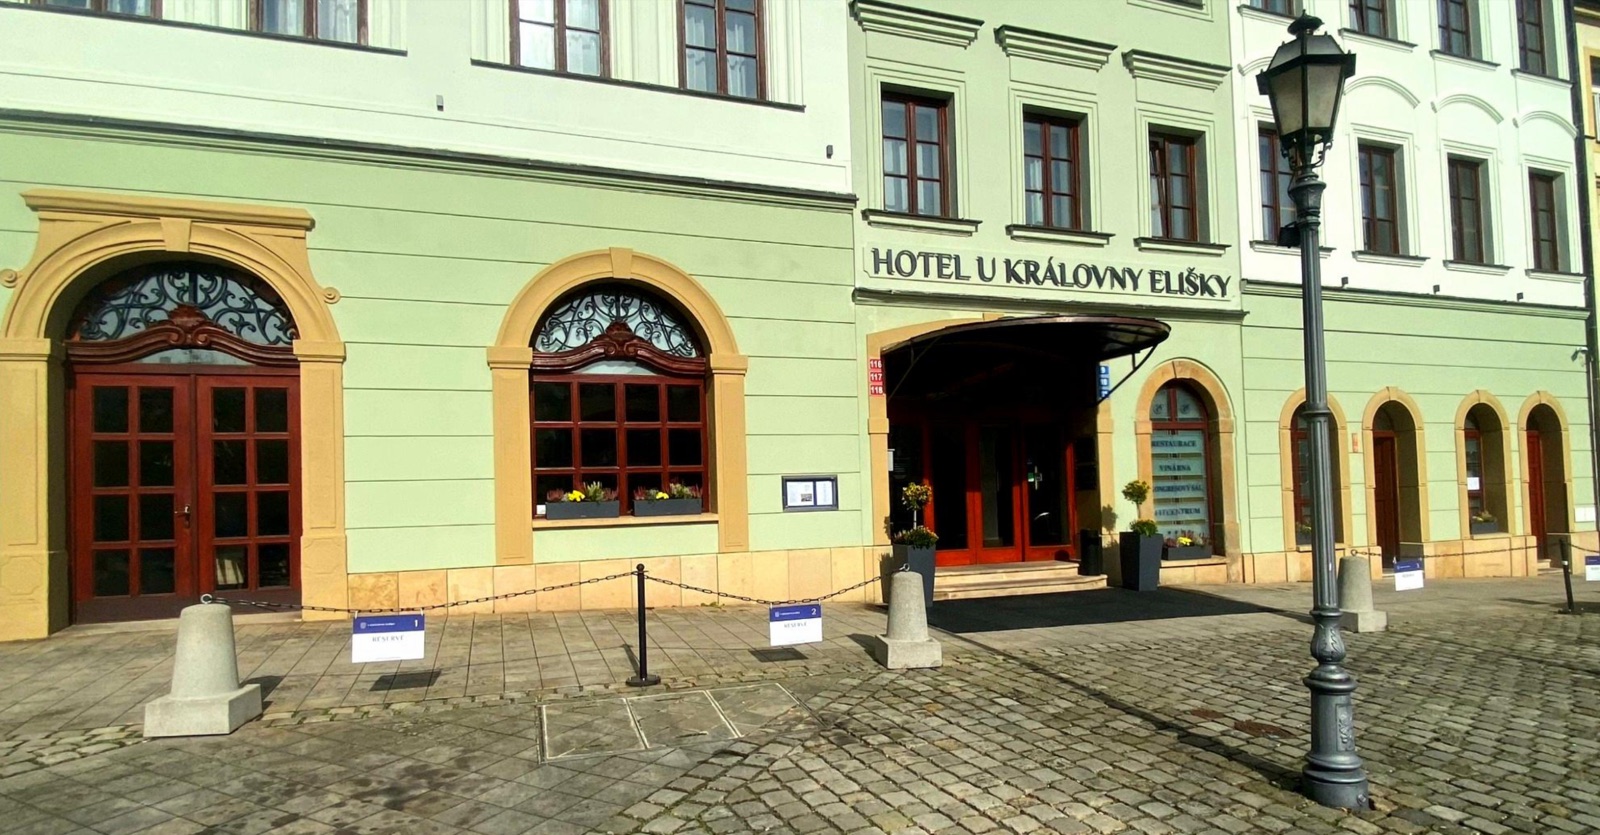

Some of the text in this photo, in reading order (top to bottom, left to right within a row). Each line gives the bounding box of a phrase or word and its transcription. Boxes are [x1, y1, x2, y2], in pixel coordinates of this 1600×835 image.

[871, 247, 1231, 298] HOTEL U KRÁLOVNY ELIŠKY
[870, 360, 882, 368] 116
[870, 373, 883, 381] 117
[871, 386, 884, 394] 118
[811, 608, 816, 616] 2
[414, 619, 418, 628] 1
